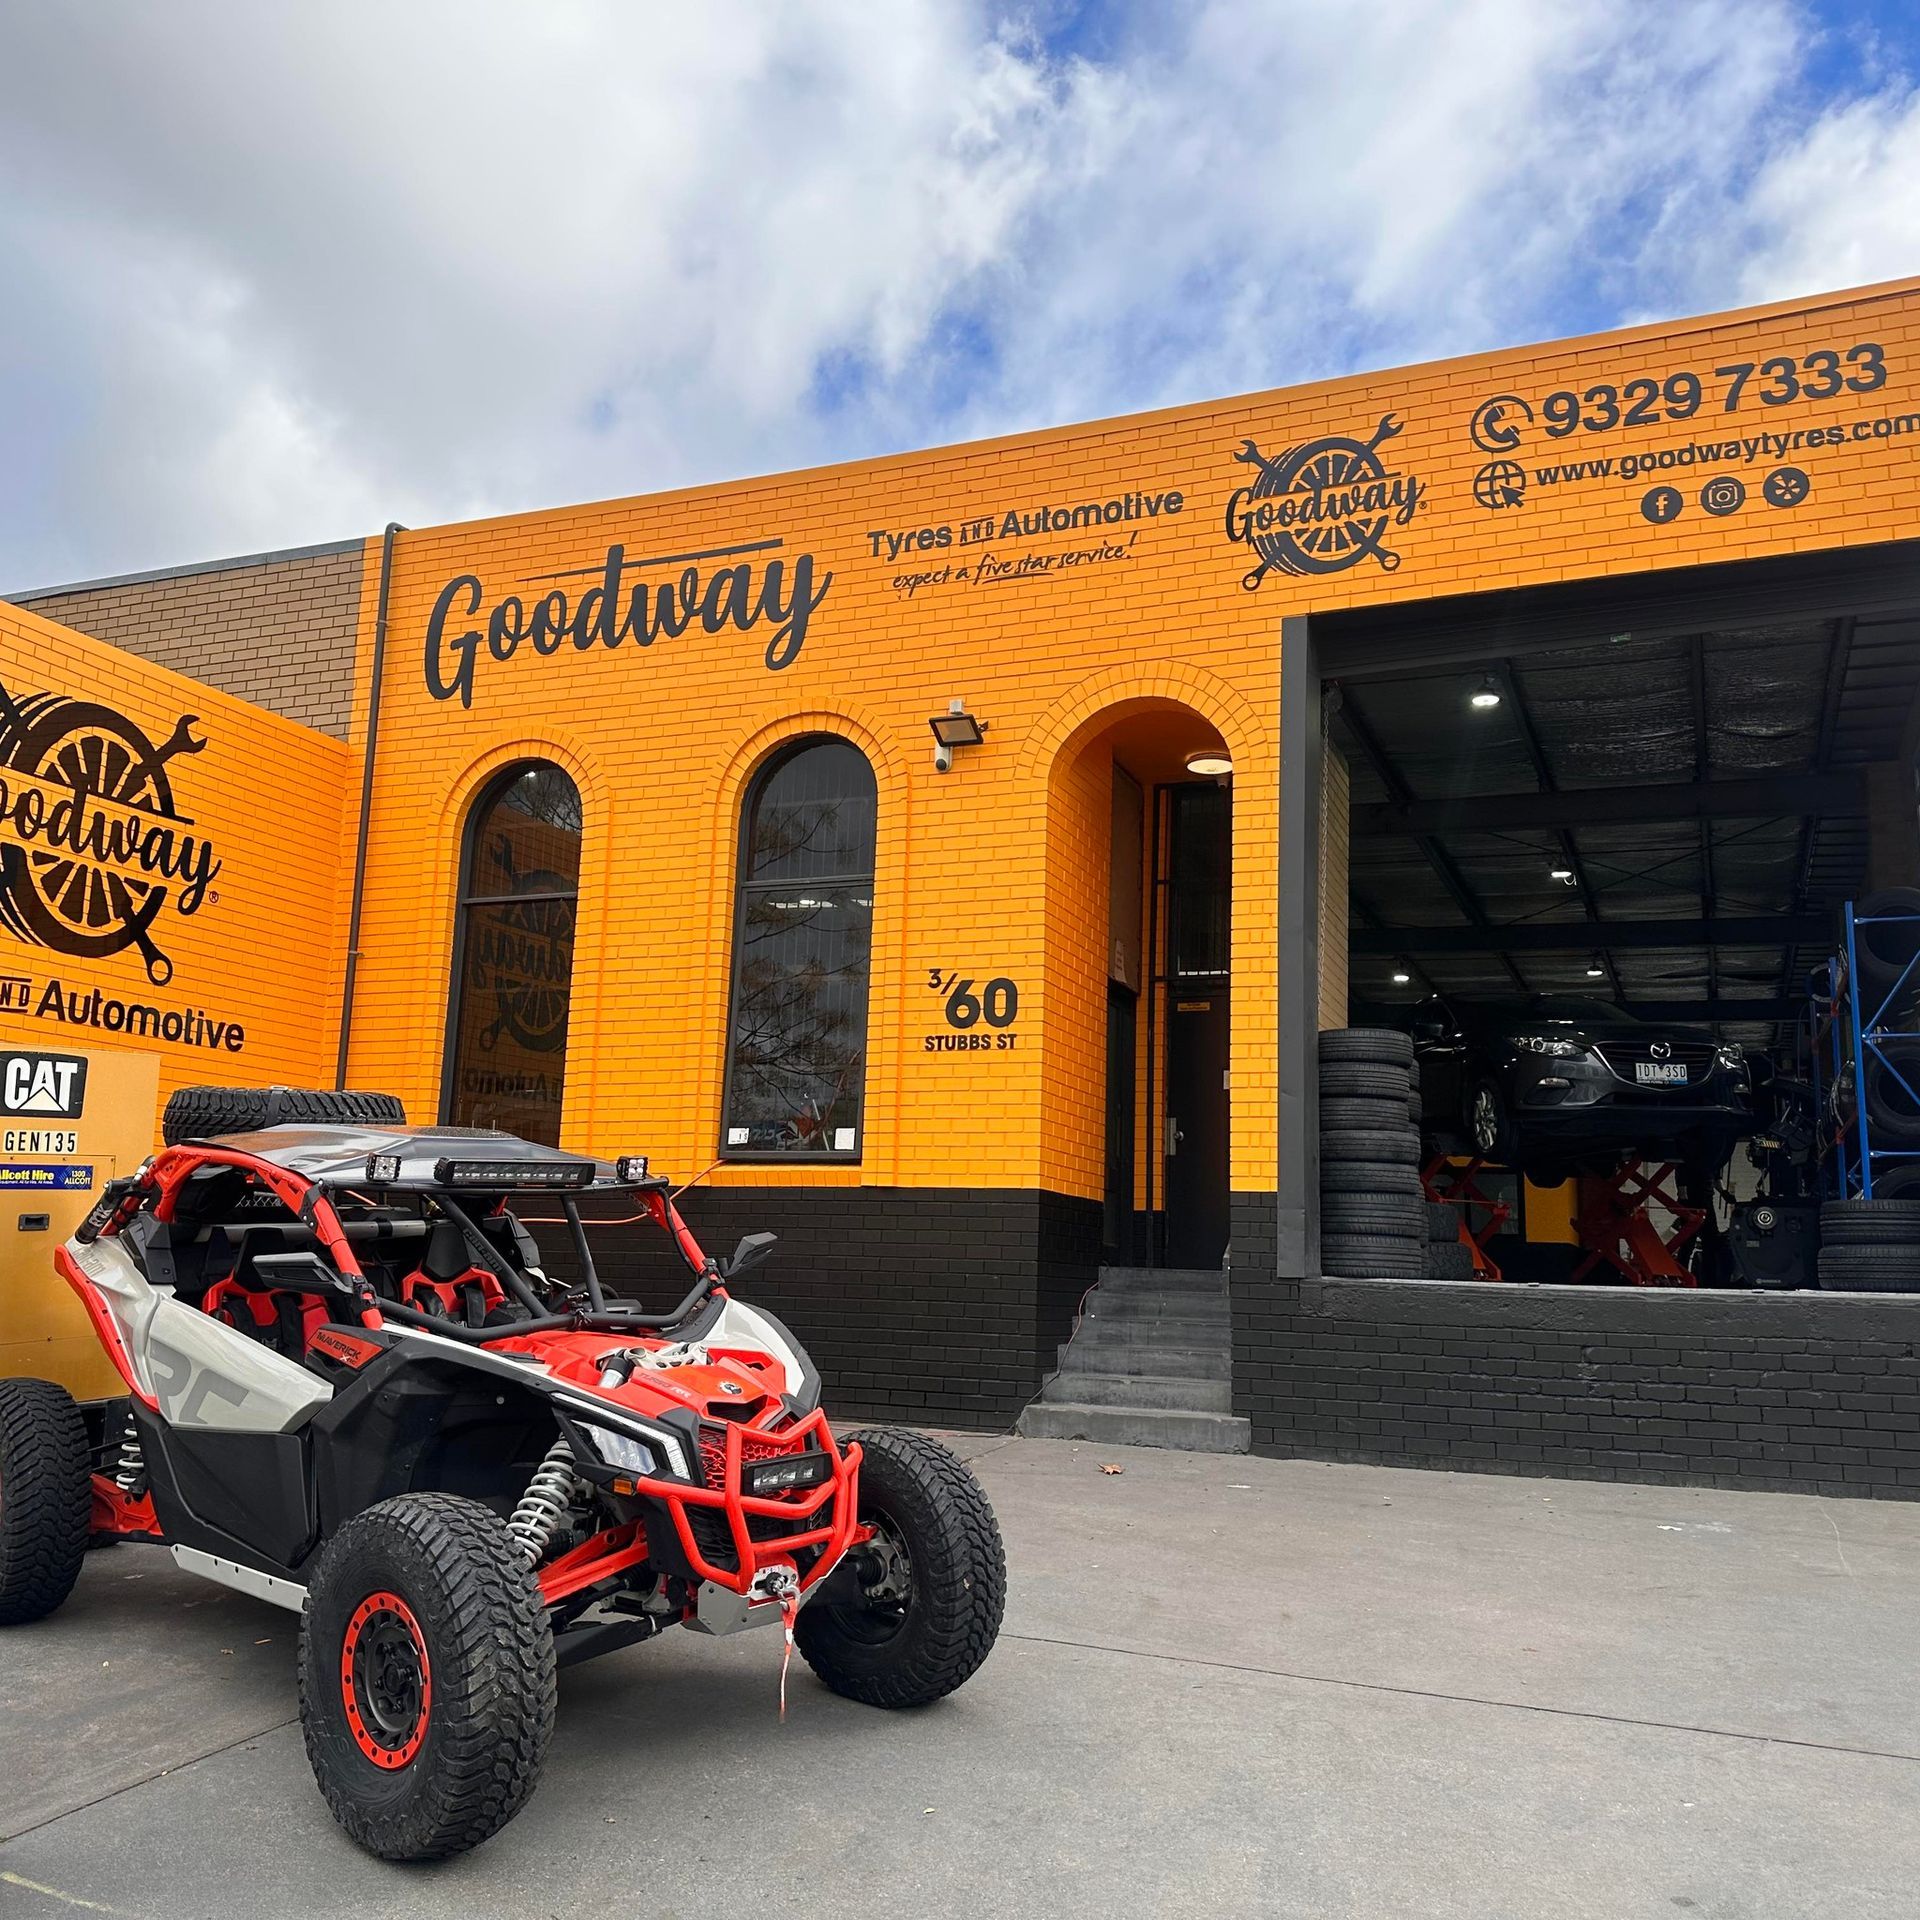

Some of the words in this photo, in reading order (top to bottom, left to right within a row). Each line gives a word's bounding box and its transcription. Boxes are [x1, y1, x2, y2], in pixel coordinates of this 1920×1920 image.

[1542, 371, 1702, 438] 9329
[1714, 342, 1888, 413] 7333
[1535, 413, 1920, 486] www.goodwaytyres.com
[867, 525, 952, 562] Tyres
[960, 517, 994, 545] AND
[999, 490, 1184, 539] Automotive
[1226, 473, 1426, 545] Goodway
[893, 564, 953, 598] expect
[955, 567, 971, 580] a
[424, 543, 833, 710] Goodway
[0, 778, 222, 915] odway
[35, 980, 245, 1052] Automotive
[927, 968, 1018, 1029] 3/60
[924, 1034, 992, 1052] STUBBS
[996, 1033, 1017, 1050] ST
[4, 1057, 79, 1112] CAT
[0, 1169, 30, 1180] llcott
[32, 1169, 55, 1181] Hire
[5, 1131, 76, 1153] GEN135
[316, 1331, 362, 1359] MAVERICK
